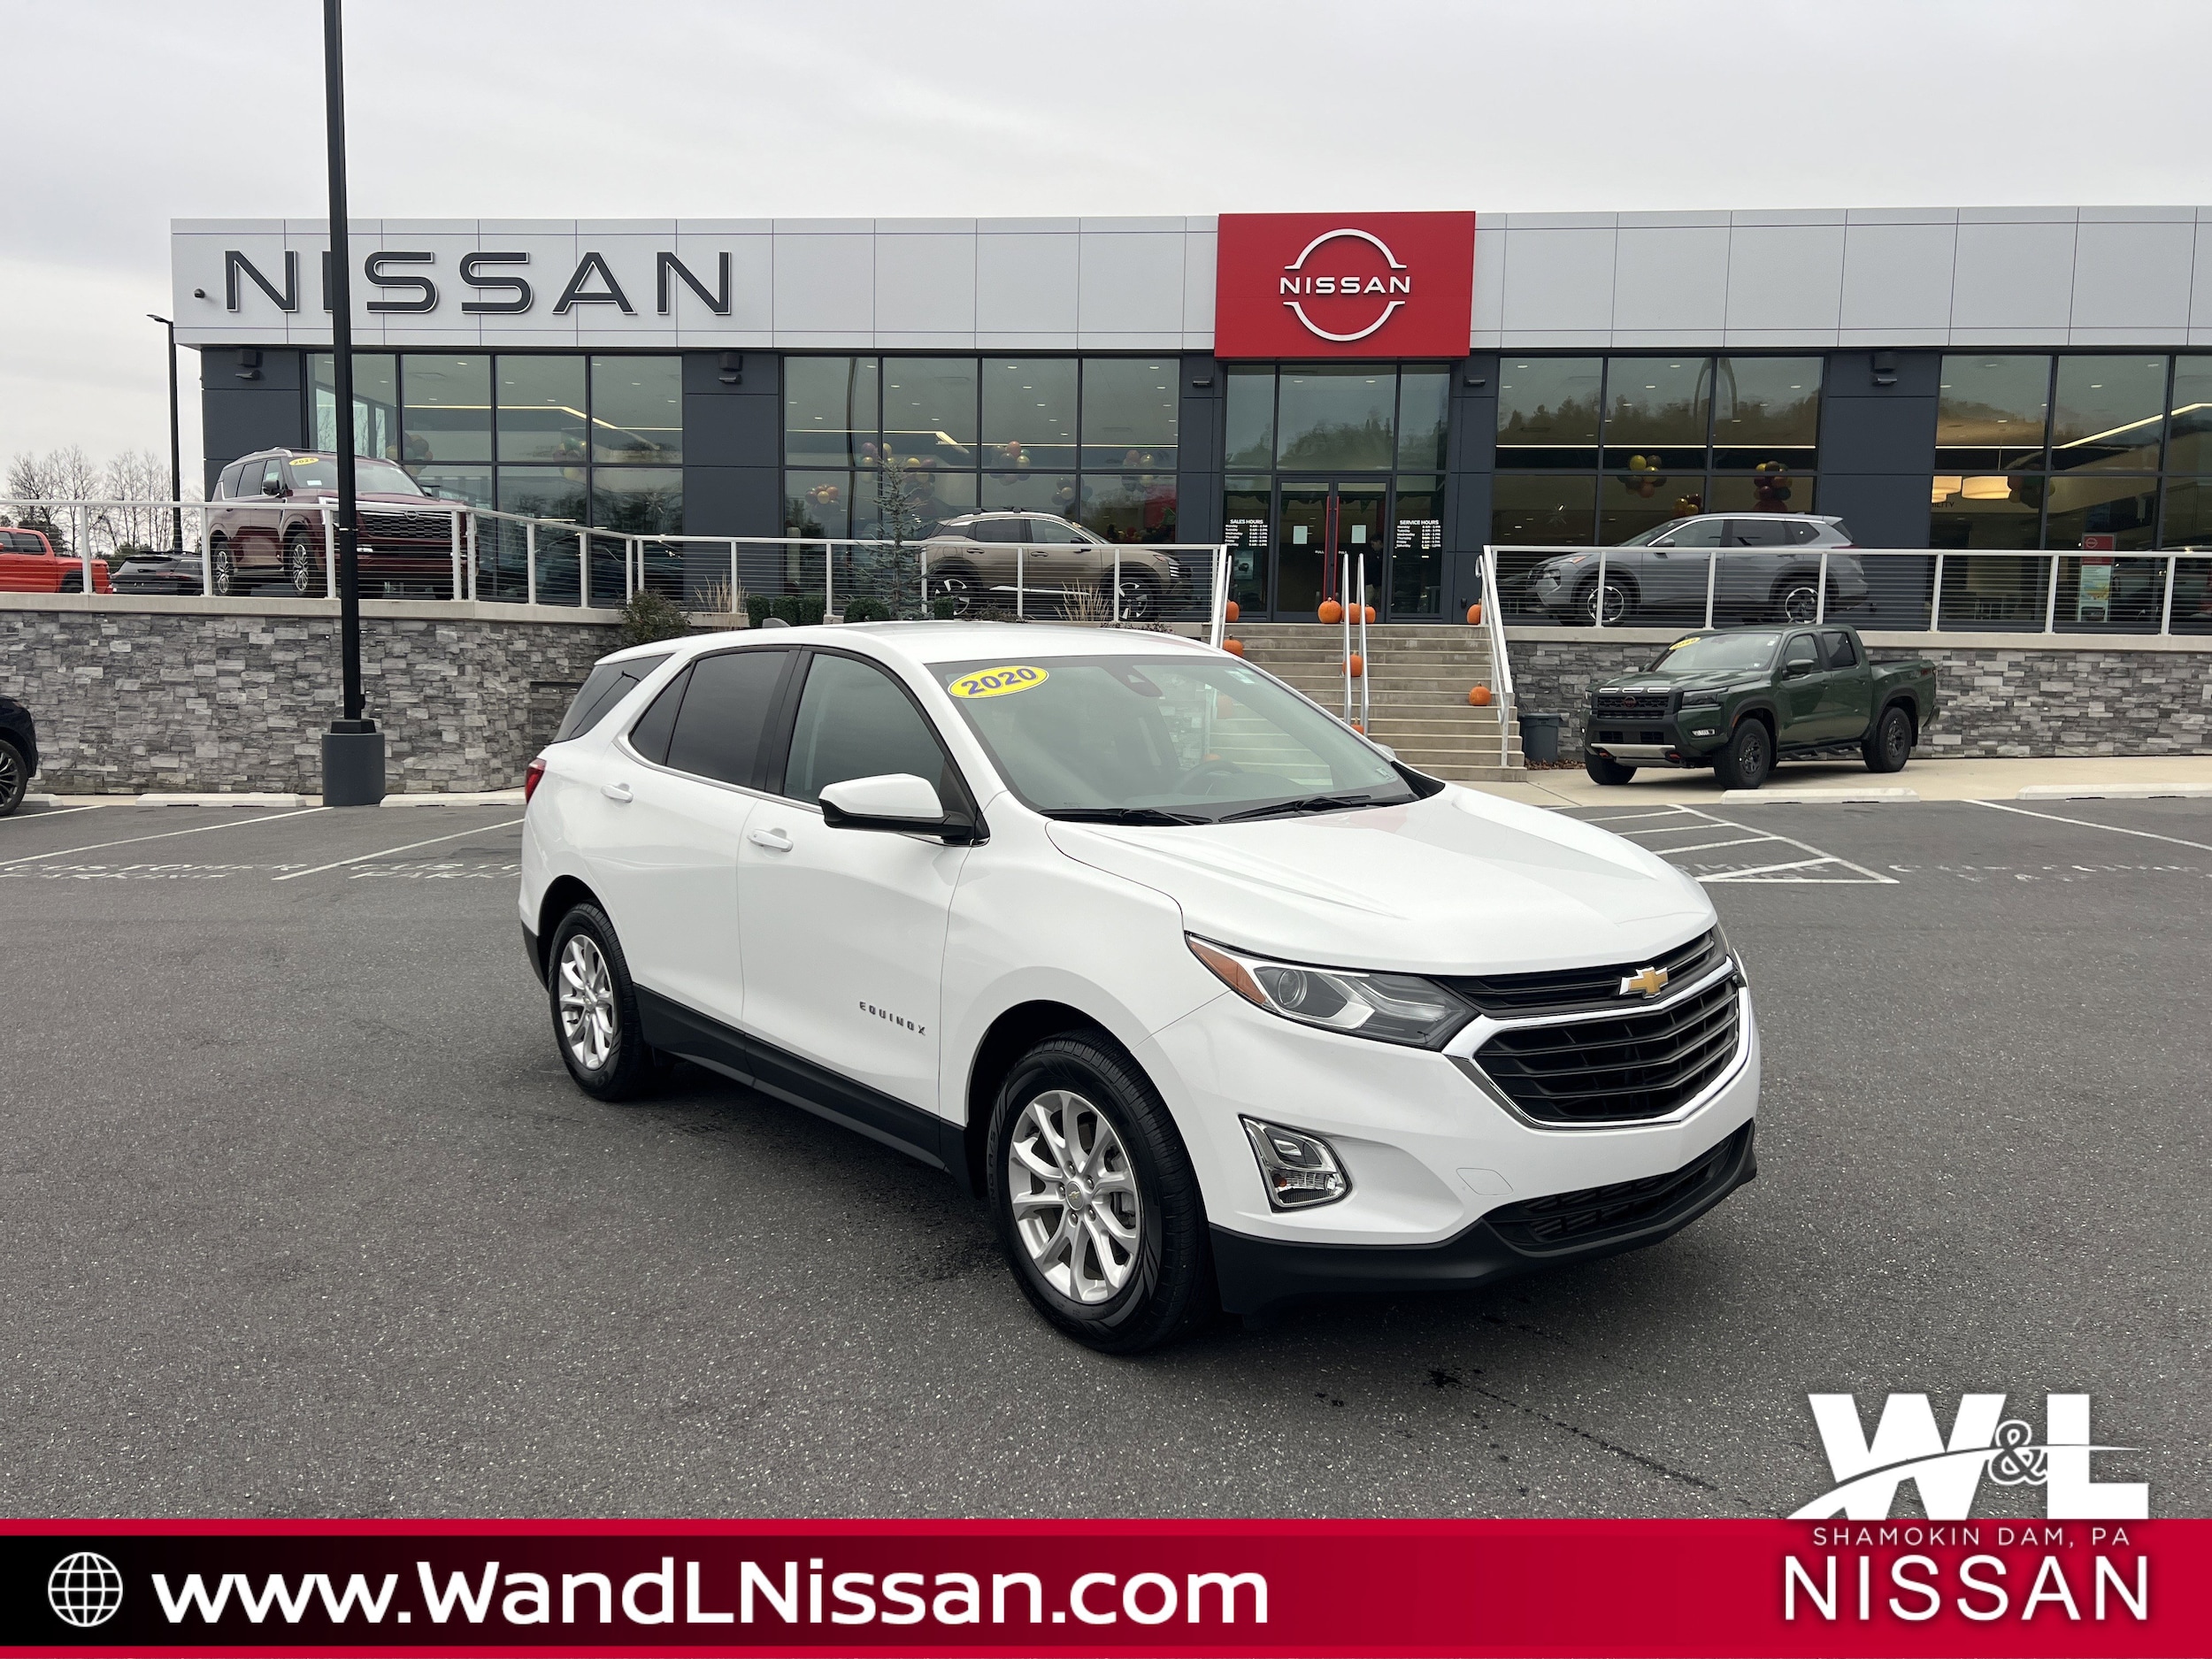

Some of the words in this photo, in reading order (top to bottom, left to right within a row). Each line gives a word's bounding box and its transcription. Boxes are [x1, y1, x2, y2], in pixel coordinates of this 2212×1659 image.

[225, 250, 732, 315] NISSAN
[1279, 276, 1411, 295] NISSAN
[961, 668, 1038, 695] 2020
[859, 1001, 926, 1036] EQUINOX
